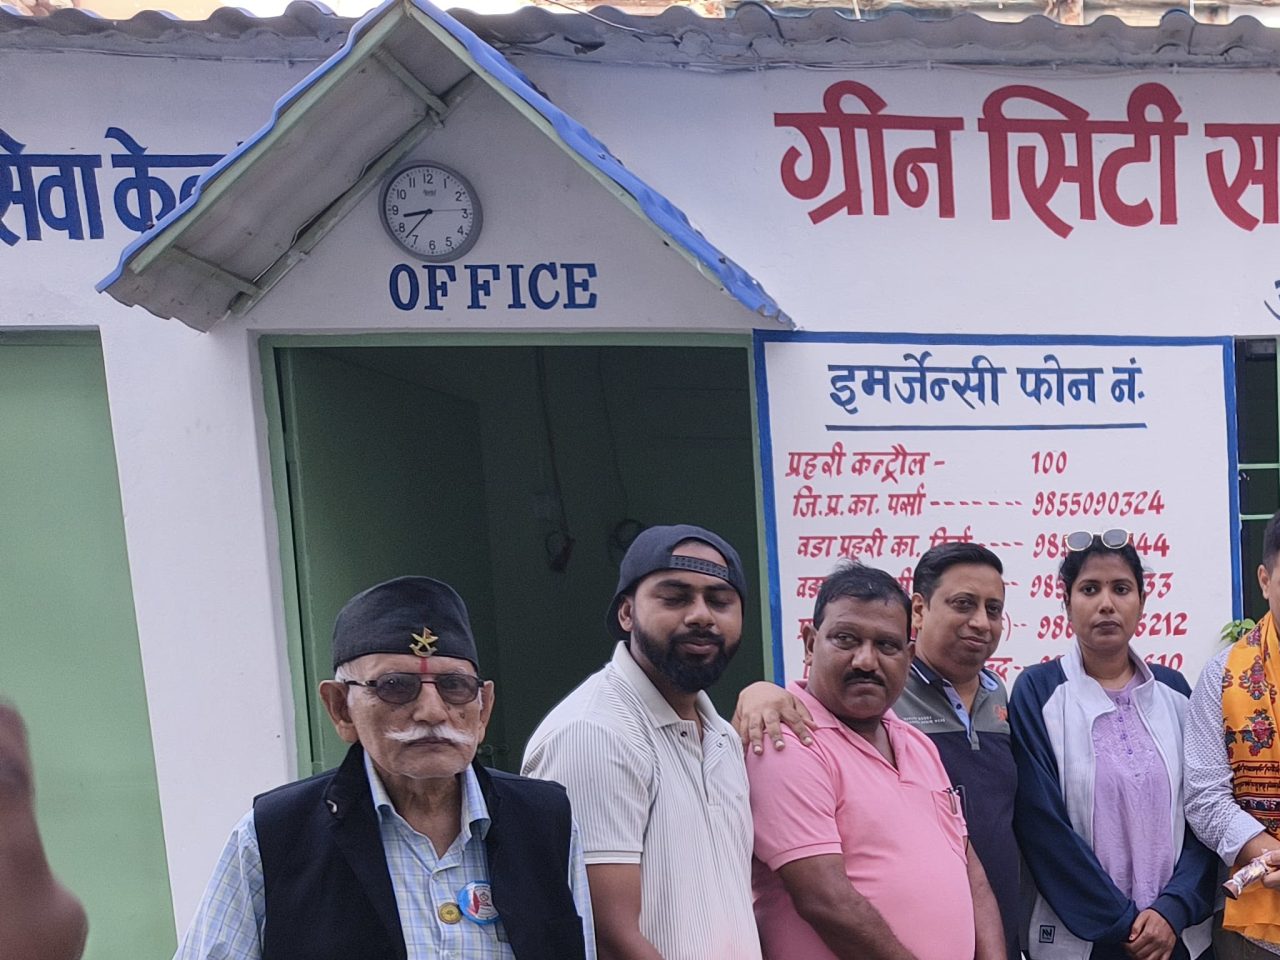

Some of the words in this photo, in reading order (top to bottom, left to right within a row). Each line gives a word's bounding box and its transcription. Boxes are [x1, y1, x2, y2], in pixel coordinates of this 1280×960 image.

[774, 80, 964, 225] ग्रीन
[978, 82, 1189, 239] सिटी
[409, 177, 416, 188] 11
[423, 173, 434, 185] 12
[443, 178, 448, 189] 1
[397, 189, 407, 200] 10
[455, 191, 462, 202] 2
[392, 205, 399, 216] 9
[461, 208, 469, 219] 3
[398, 222, 406, 233] 8
[457, 225, 464, 236] 4
[412, 234, 419, 245] 7
[429, 240, 436, 250] 6
[445, 236, 452, 247] 5
[389, 263, 597, 310] OFFICE
[1016, 354, 1104, 406] फोन
[785, 441, 846, 480] प्रहरी
[1031, 451, 1067, 474] 100
[888, 483, 926, 516] पर्सा
[1032, 490, 1165, 516] 9855090324
[797, 536, 837, 558] वडा
